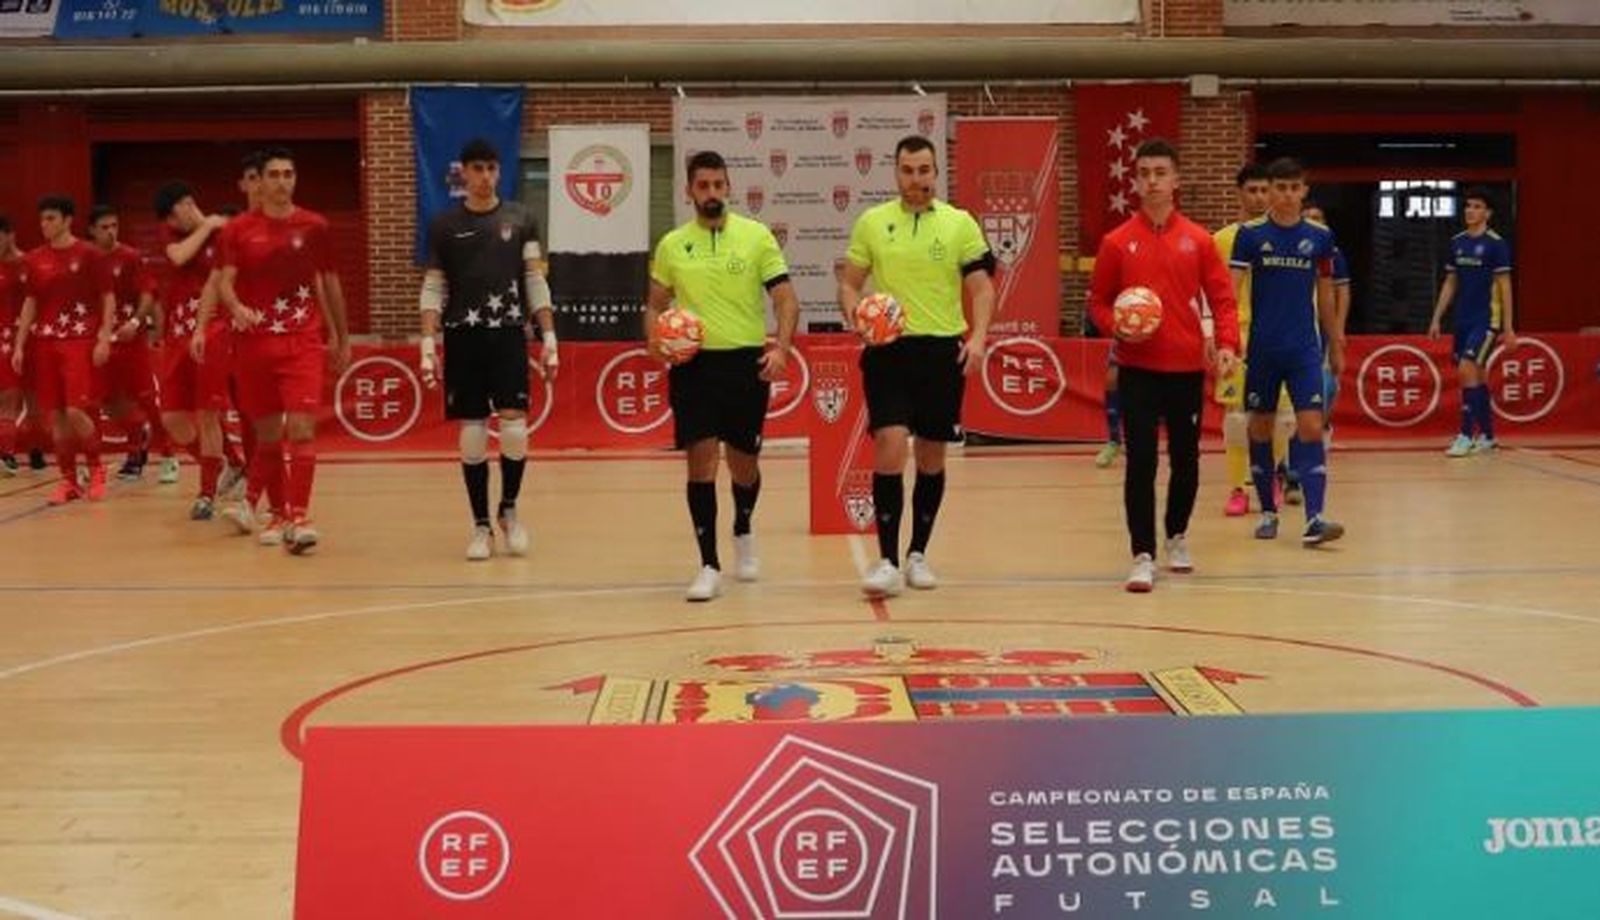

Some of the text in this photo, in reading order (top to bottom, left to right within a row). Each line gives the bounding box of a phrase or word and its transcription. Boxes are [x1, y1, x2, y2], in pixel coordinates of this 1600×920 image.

[1376, 365, 1420, 383] RF
[1501, 358, 1546, 377] RF
[355, 377, 401, 397] RF
[617, 370, 661, 390] RF
[1003, 375, 1047, 393] EF
[1377, 388, 1420, 408] EF
[1502, 382, 1546, 402] EF
[355, 401, 401, 420] EF
[617, 393, 661, 415] EF
[989, 782, 1330, 806] CAMPEONATO DE ESPAÑA
[796, 830, 849, 851] RF
[990, 815, 1335, 846] SELECCIONES
[440, 832, 490, 852] RF
[440, 857, 490, 877] EF
[796, 858, 849, 879] EF
[992, 844, 1338, 878] AUTONÓMICAS
